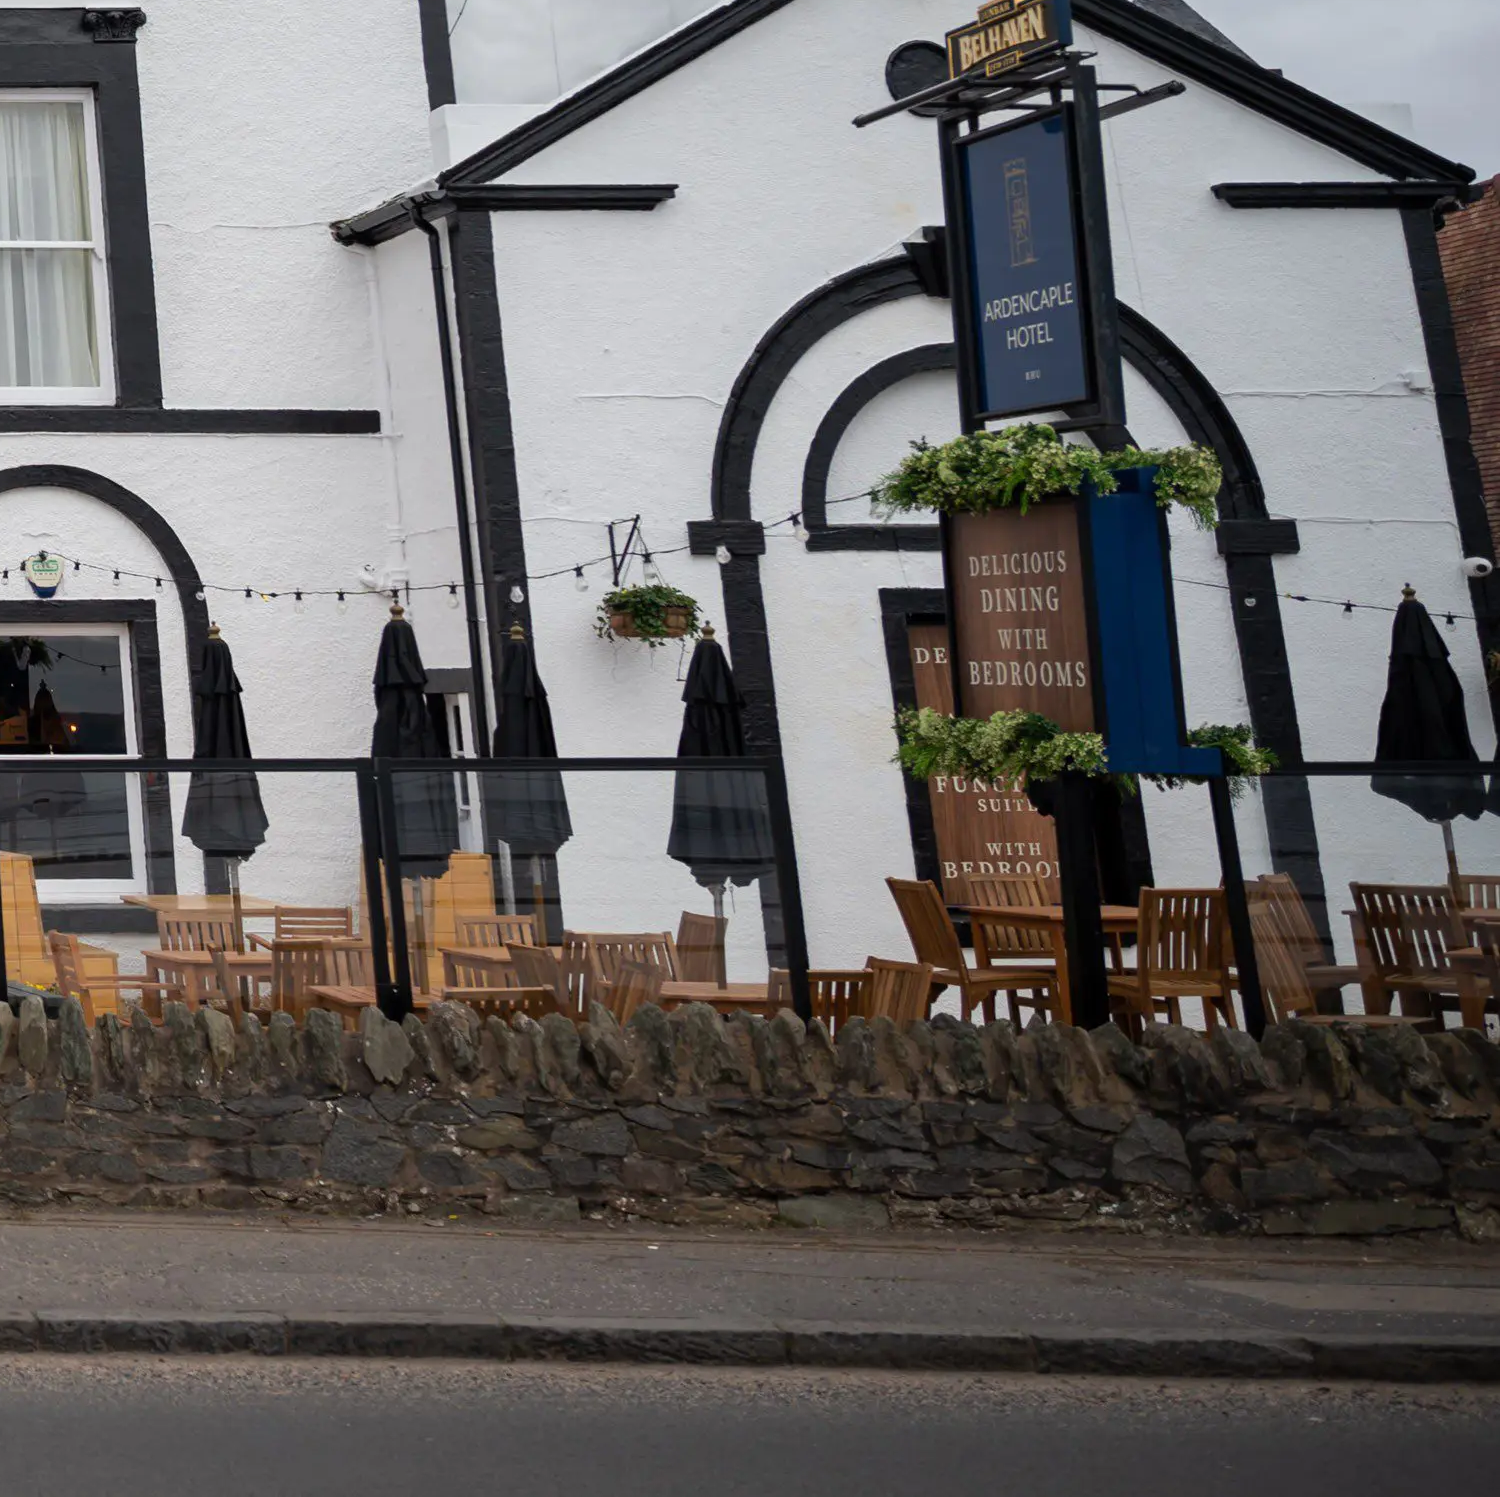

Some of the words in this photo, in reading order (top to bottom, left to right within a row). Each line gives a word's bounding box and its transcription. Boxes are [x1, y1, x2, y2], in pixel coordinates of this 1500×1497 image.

[958, 3, 1047, 71] BELHAVEN
[984, 282, 1073, 322] ARDENCAPLE
[1006, 321, 1054, 350] HOTEL
[968, 550, 1067, 577] DELICIOUS
[980, 586, 1060, 613] DINING
[997, 628, 1048, 650] WITH
[968, 660, 1086, 688] BEDROOMS
[935, 776, 1023, 793] FUNCT
[985, 842, 1042, 856] WITH
[943, 861, 1060, 879] BEDROO
